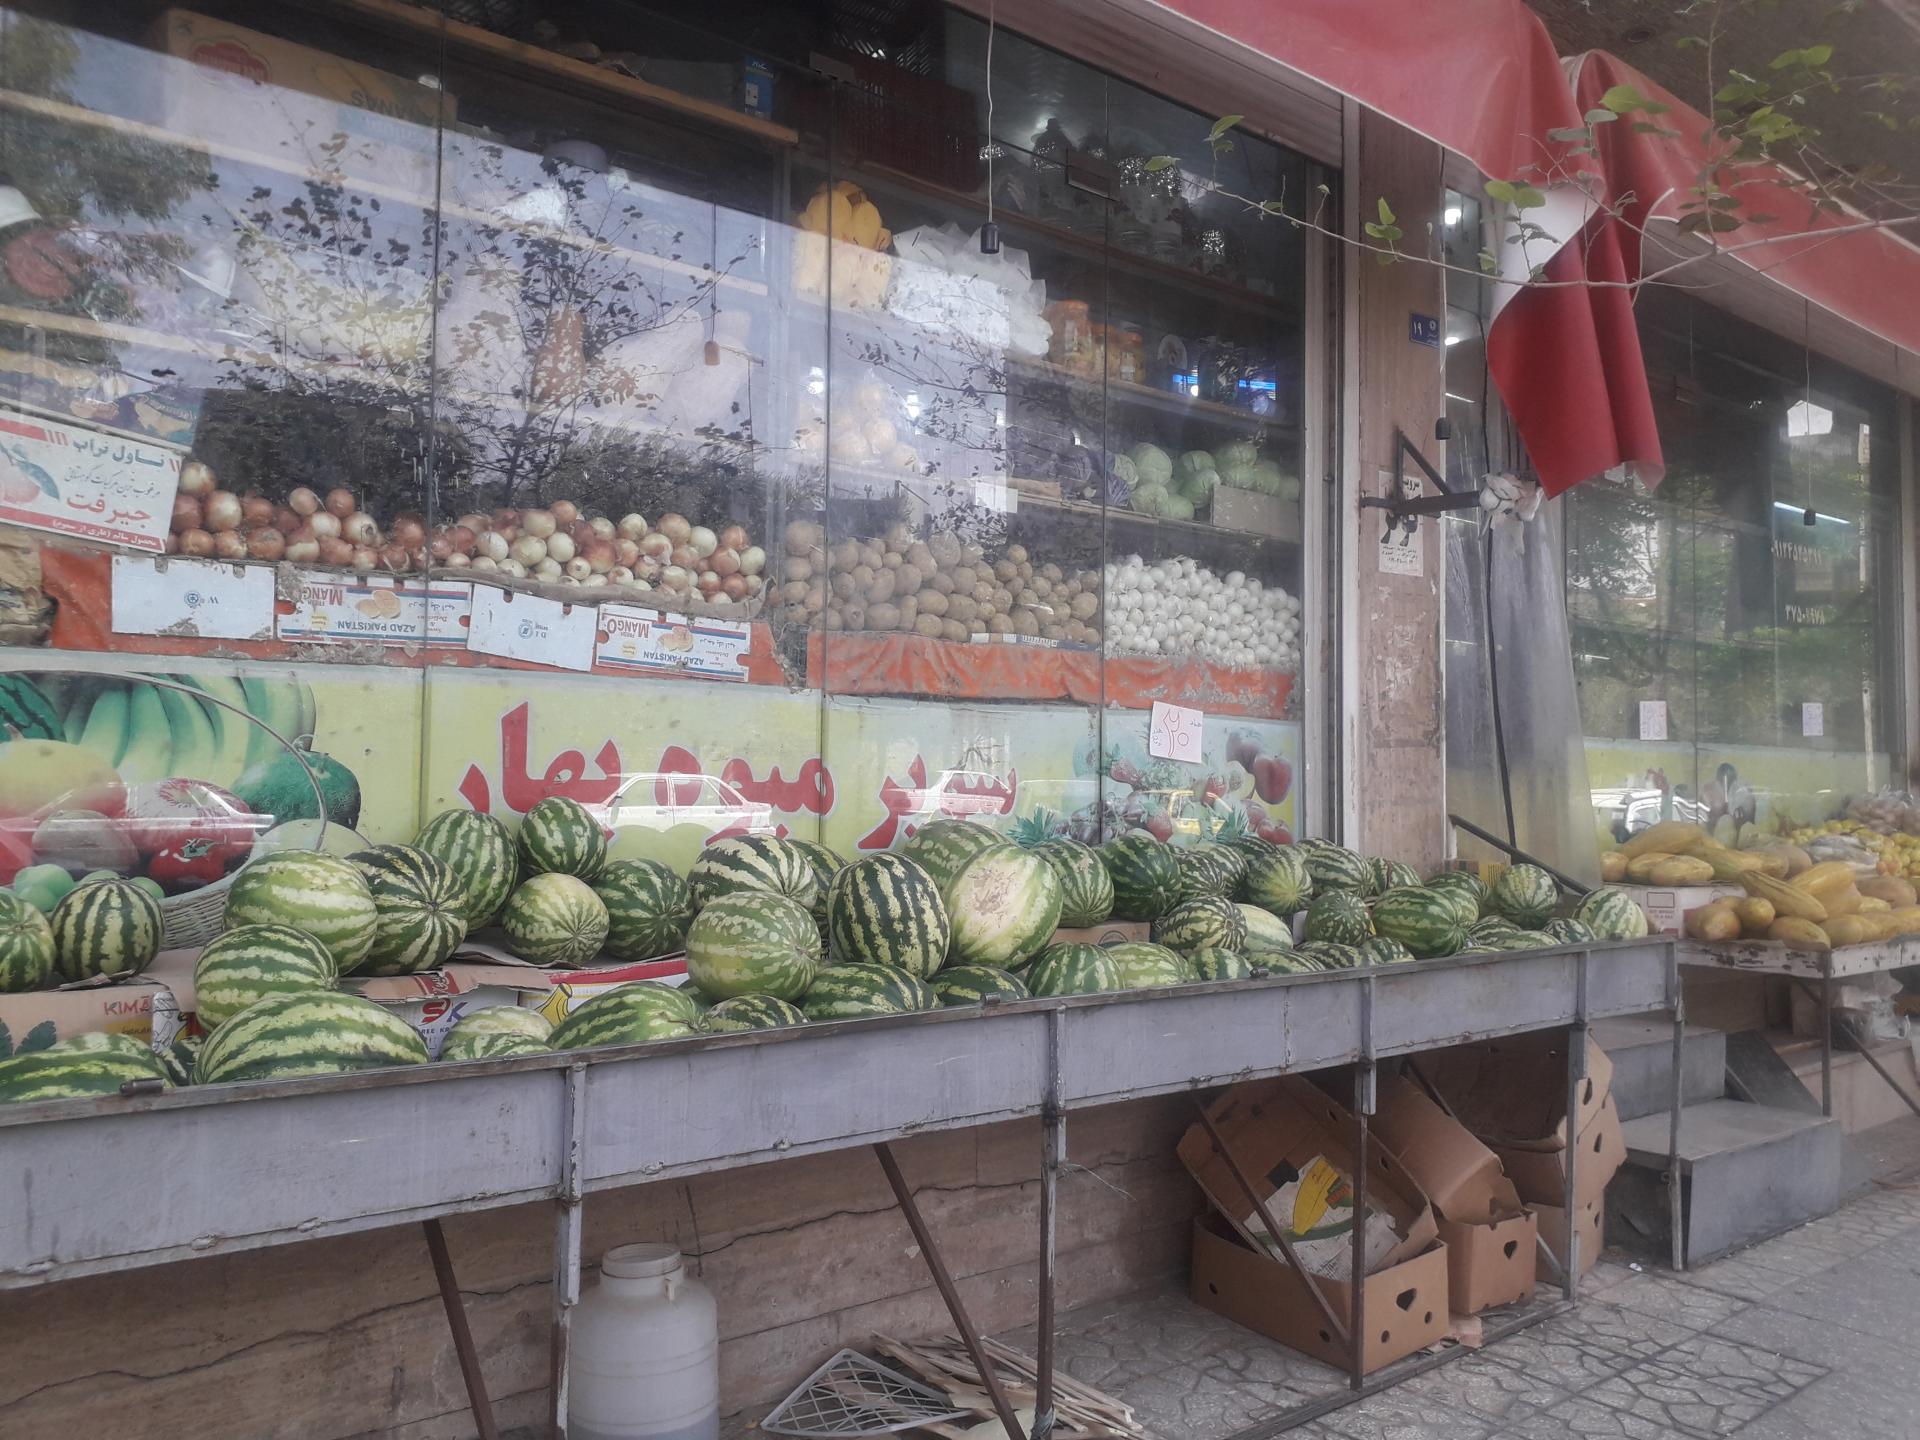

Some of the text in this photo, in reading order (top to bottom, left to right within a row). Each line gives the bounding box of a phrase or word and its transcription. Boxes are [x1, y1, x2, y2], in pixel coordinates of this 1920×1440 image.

[67, 493, 152, 528] جیرفت
[301, 585, 343, 606] MANG
[337, 620, 387, 633] PAKISTAN
[389, 623, 416, 633] AZAD
[607, 618, 650, 638] MANGO
[458, 701, 620, 844] بهار
[654, 745, 835, 846] میوه
